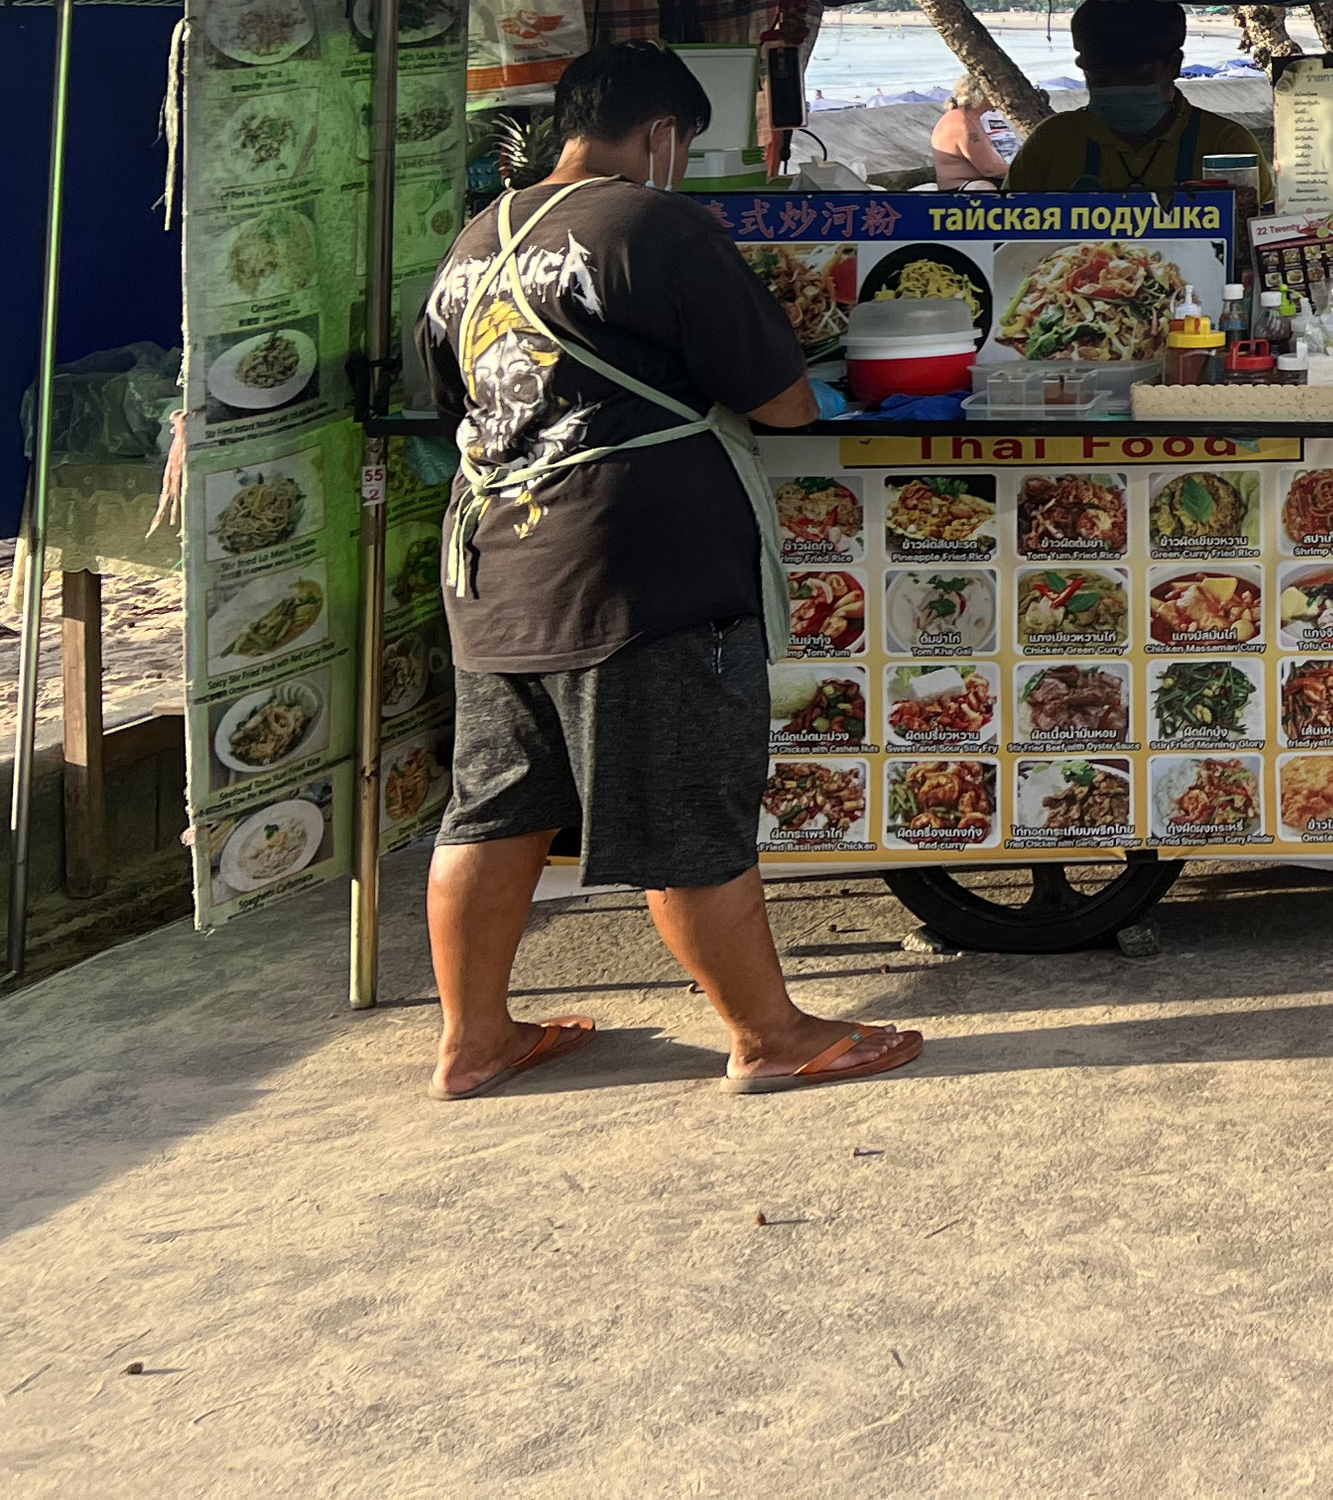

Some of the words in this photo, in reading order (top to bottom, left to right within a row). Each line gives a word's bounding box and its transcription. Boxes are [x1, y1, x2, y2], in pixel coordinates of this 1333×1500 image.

[929, 199, 1056, 232] тайская
[1070, 203, 1220, 238] подушка
[1256, 227, 1268, 236] 22
[1269, 222, 1301, 234] Twenty
[915, 435, 1046, 460] Thai
[1082, 435, 1238, 459] Food
[364, 467, 384, 483] 55
[368, 487, 381, 501] 2
[1027, 552, 1047, 561] Tom
[1049, 552, 1072, 561] Yum
[1074, 551, 1097, 561] Fried
[1099, 551, 1121, 560] Rice
[1151, 549, 1181, 559] Green
[1182, 549, 1210, 560] Curry
[1211, 548, 1236, 558] Fried
[1237, 548, 1260, 558] Rice
[1294, 546, 1329, 557] Shrimp
[804, 554, 830, 564] Fried
[831, 554, 853, 564] Rice
[892, 553, 940, 564] Pineapple
[942, 553, 966, 562] Fried
[968, 552, 990, 562] Rice
[1024, 646, 1063, 655] Chicken
[1065, 646, 1095, 655] Green
[1097, 645, 1124, 656] Curry
[1145, 645, 1184, 654] Chicken
[1186, 644, 1238, 653] Massaman
[1239, 642, 1266, 653] Curry
[1298, 641, 1320, 650] Tofu
[806, 648, 825, 657] Tom
[827, 648, 850, 657] Yum
[912, 647, 931, 656] Tom
[934, 647, 953, 656] Kha
[955, 647, 972, 656] Gai
[886, 744, 914, 754] Sweet
[916, 744, 936, 753] and
[938, 744, 961, 753] Sour
[962, 744, 981, 753] Stir
[982, 744, 998, 755] Fry
[1150, 740, 1169, 750] Stir
[1170, 740, 1194, 750] Fried
[1197, 740, 1236, 750] Morning
[1238, 739, 1265, 751] Glory
[1287, 739, 1313, 749] fried
[759, 843, 785, 852] Fried
[786, 843, 813, 852] Basil
[813, 842, 835, 852] with
[836, 842, 877, 851] Chicken
[918, 841, 937, 851] Red
[938, 841, 966, 852] curry
[1005, 841, 1025, 850] Fried
